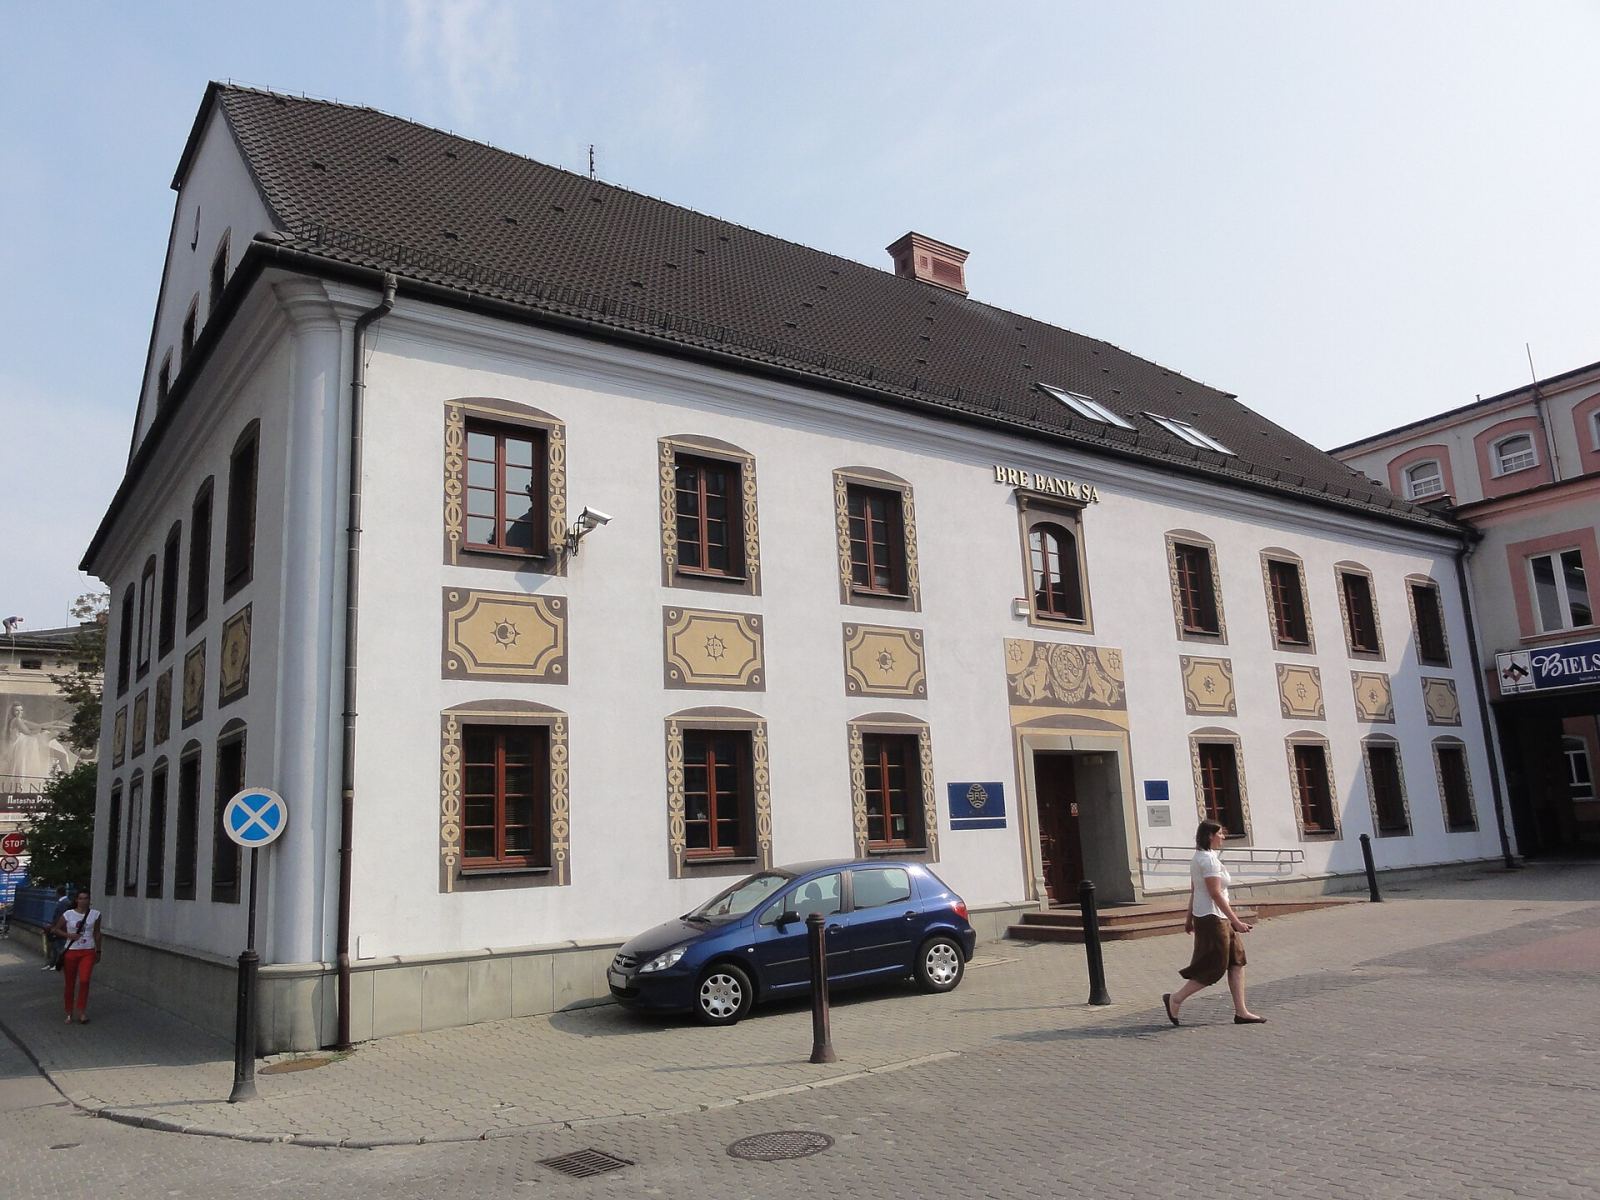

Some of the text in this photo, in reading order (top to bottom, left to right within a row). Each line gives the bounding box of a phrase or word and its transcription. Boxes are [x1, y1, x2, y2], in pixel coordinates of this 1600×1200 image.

[993, 465, 1100, 503] BRE BANK SA
[4, 840, 25, 848] STOP
